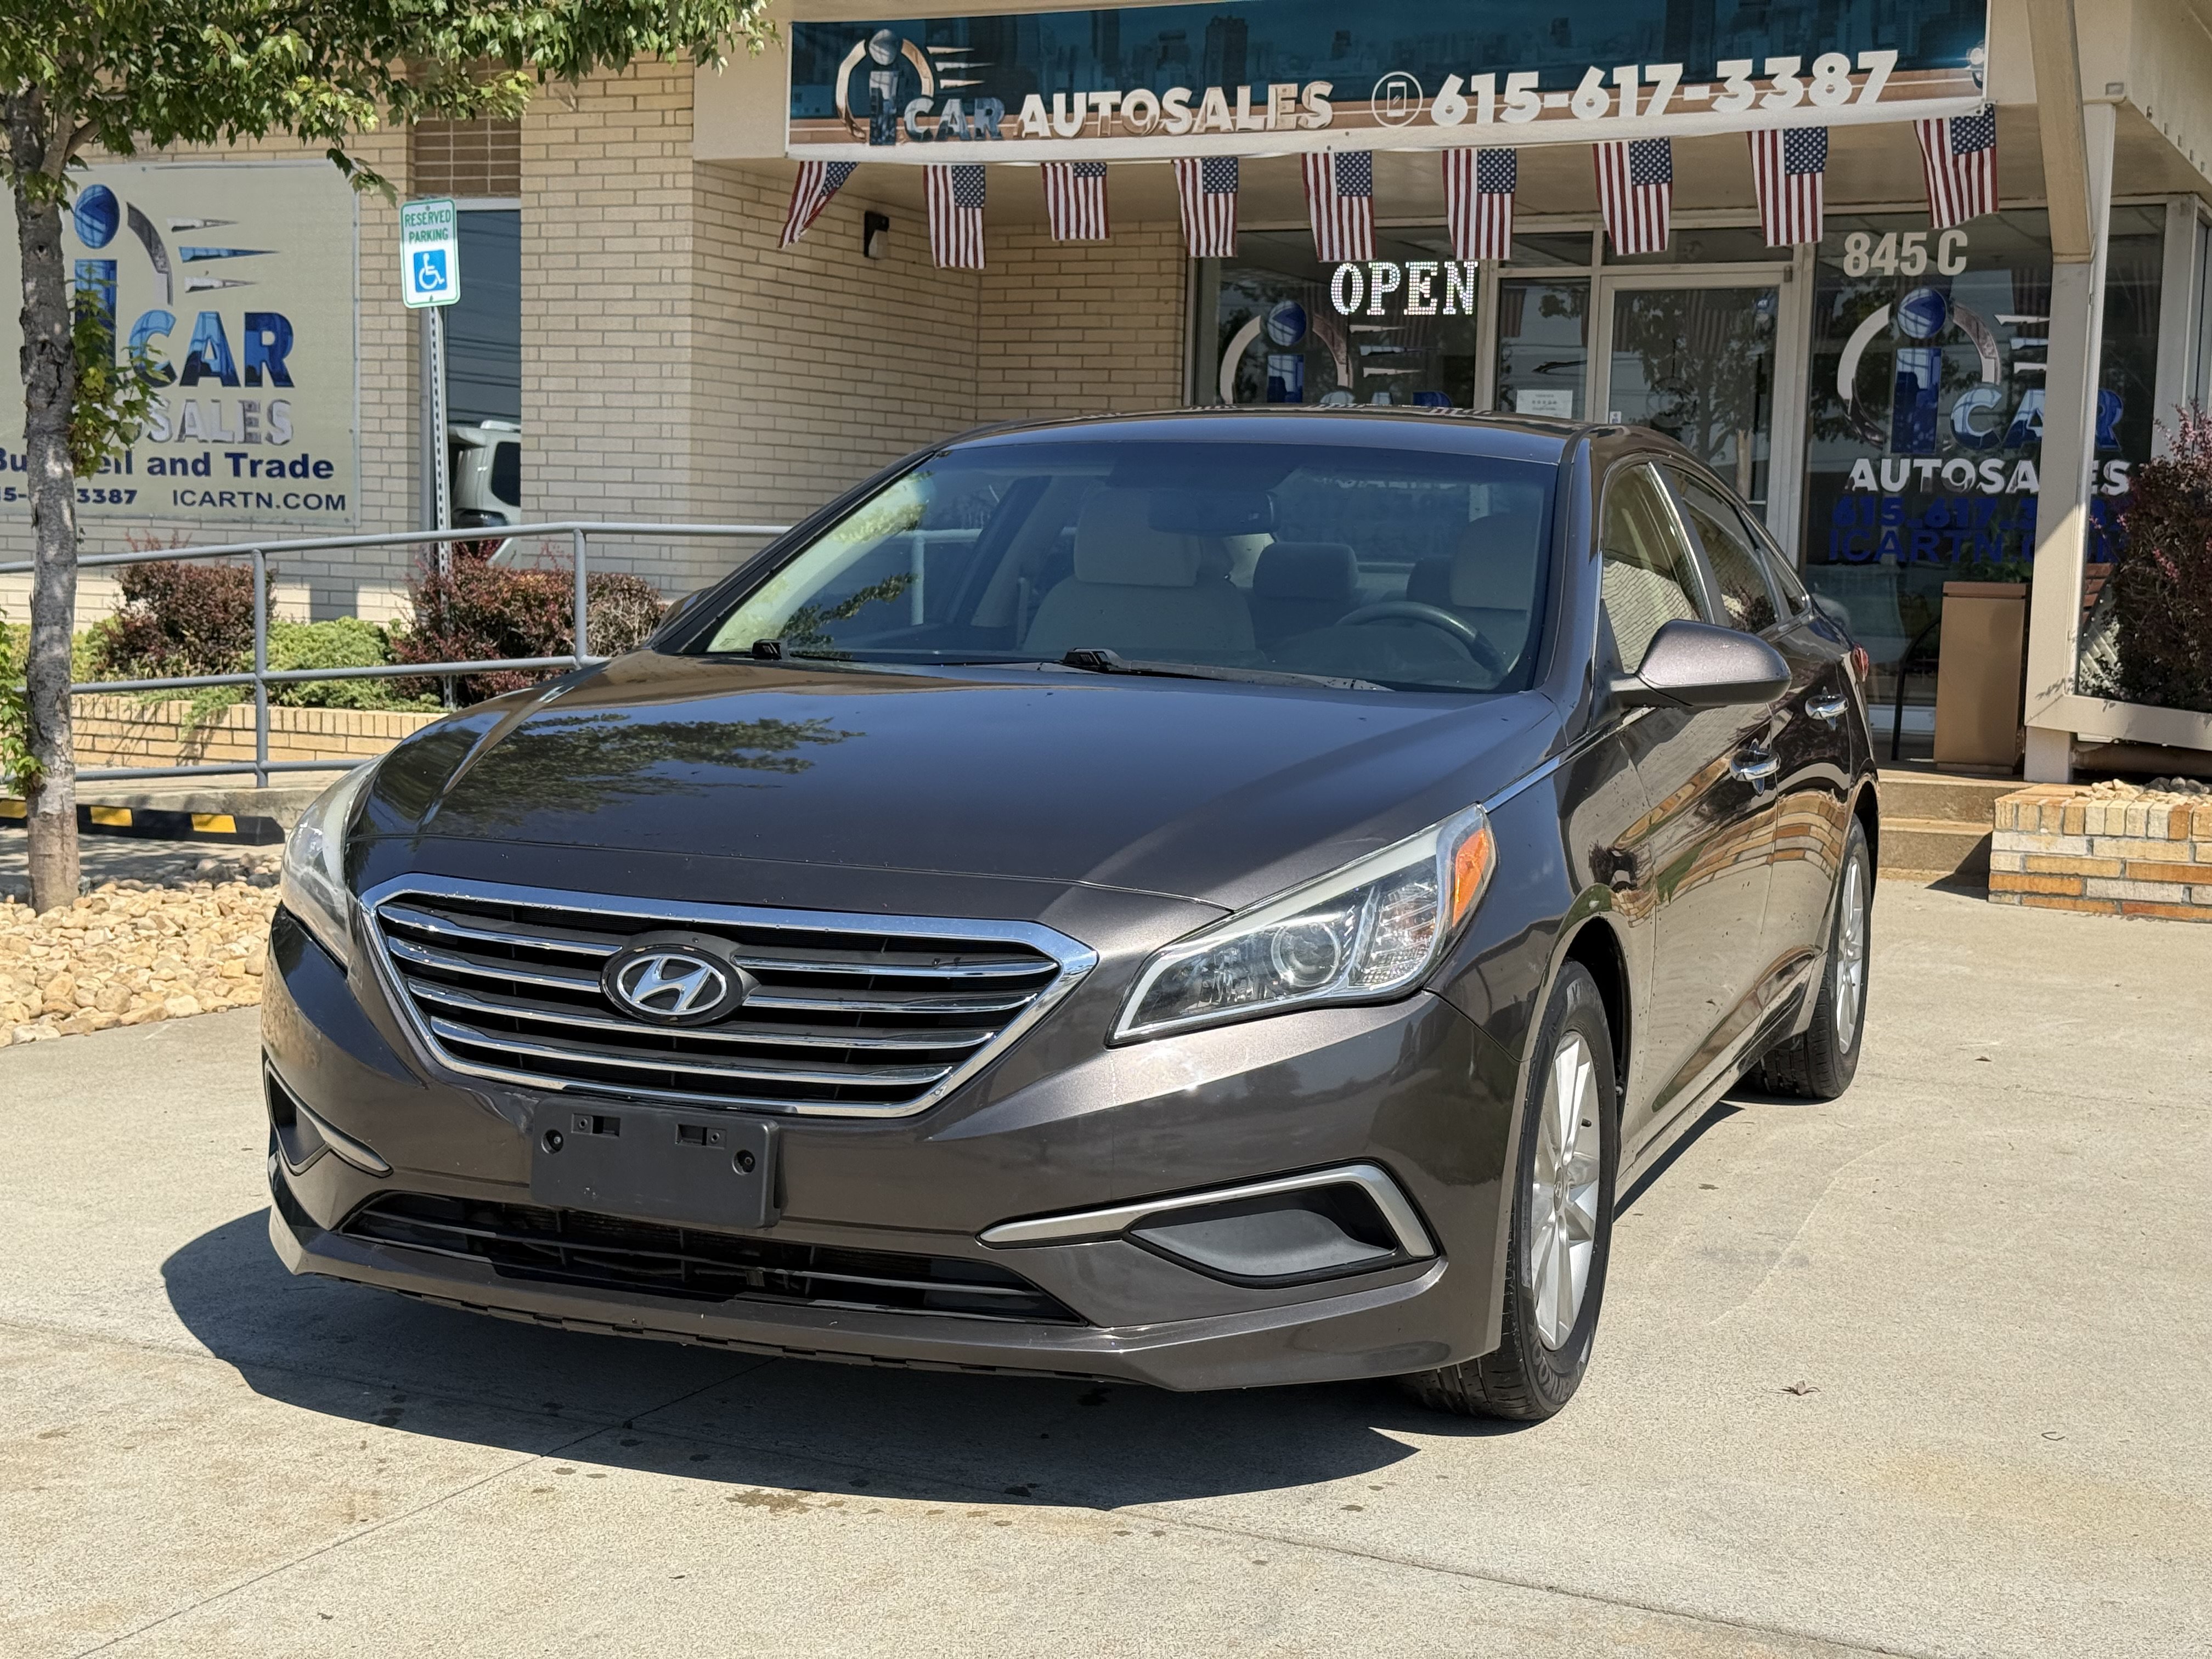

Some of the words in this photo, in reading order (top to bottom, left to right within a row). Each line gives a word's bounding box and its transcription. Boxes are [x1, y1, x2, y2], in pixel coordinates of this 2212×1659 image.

[1015, 81, 1333, 138] AUTOSALES
[1431, 50, 1898, 126] 615-617-3387
[405, 210, 451, 227] RESERVED
[409, 228, 449, 244] PARKING
[1843, 232, 1927, 277] 845
[1938, 229, 1968, 275] C
[1330, 261, 1478, 315] OPEN
[147, 452, 211, 478] and
[224, 452, 334, 479] Trade
[1846, 459, 2132, 495] AUTOSAS
[173, 489, 346, 511] ICARTN.COM
